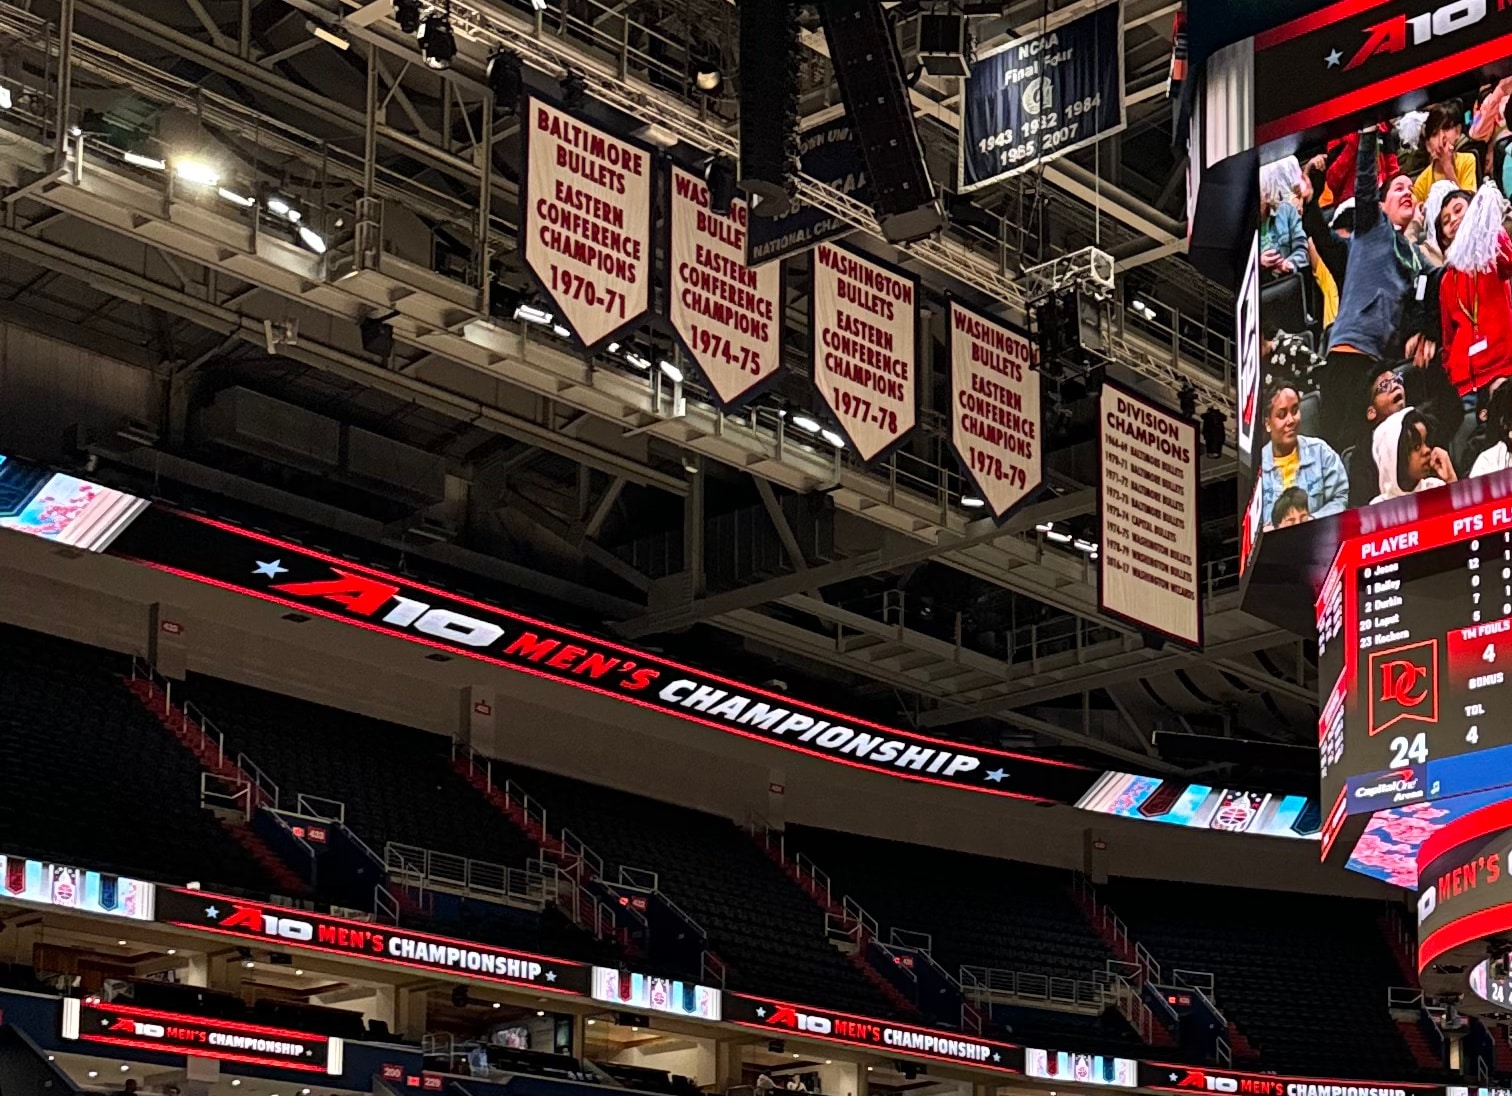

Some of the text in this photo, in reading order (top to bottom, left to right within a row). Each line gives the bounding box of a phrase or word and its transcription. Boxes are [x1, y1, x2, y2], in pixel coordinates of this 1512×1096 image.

[1342, 0, 1486, 72] A10
[1005, 61, 1038, 86] Final
[537, 107, 642, 176] BALTIMORE
[978, 129, 1012, 153] 1943
[1065, 92, 1100, 119] 1984
[1042, 123, 1078, 149] 2007
[556, 143, 625, 194] BULLETS
[555, 179, 624, 229] EASTERN
[536, 198, 641, 262] CONFERENCE
[539, 225, 636, 284] CHAMPIONS
[696, 243, 757, 290] EASTERN
[818, 245, 911, 305] WASHINGTON
[550, 264, 626, 319] 1970-71
[679, 262, 772, 321] CONFERENCE
[837, 278, 894, 321] BULLETS
[681, 288, 769, 343] CHAMPIONS
[837, 310, 893, 352] EASTERN
[691, 325, 761, 376] 1974-75
[823, 328, 908, 381] CONFERENCE
[972, 342, 1022, 382] BULLETS
[825, 352, 904, 402] CHAMPIONS
[972, 373, 1022, 413] EASTERN
[833, 387, 897, 434] 1977-78
[959, 390, 1035, 440] CONFERENCE
[1117, 398, 1179, 441] DIVISION
[961, 414, 1032, 460] CHAMPIONS
[1107, 411, 1190, 464] CHAMPIONS
[969, 447, 1026, 490] 1978-79
[1361, 531, 1419, 559] PLAYER
[1453, 514, 1483, 536] PTS
[1468, 557, 1480, 570] 12
[1360, 619, 1372, 632] 20
[1365, 602, 1372, 613] 2
[1461, 620, 1510, 640] TM FOULS
[268, 566, 981, 778] A10 MEN'S CHAMPIONSHIP
[1482, 643, 1496, 663] 4
[1468, 672, 1504, 690] BONUS
[1389, 732, 1428, 769] 24
[1465, 725, 1479, 744] 4
[1393, 789, 1424, 803] Arena
[1437, 852, 1501, 901] MEN'S
[219, 904, 542, 980] A10 MEN'S CHAMPIONSHIP
[166, 1026, 206, 1043] MEN'S
[208, 1033, 304, 1056] CHAMPIONSHIP
[766, 1006, 991, 1061] A10 MEN'S CHAMPIONSHIP
